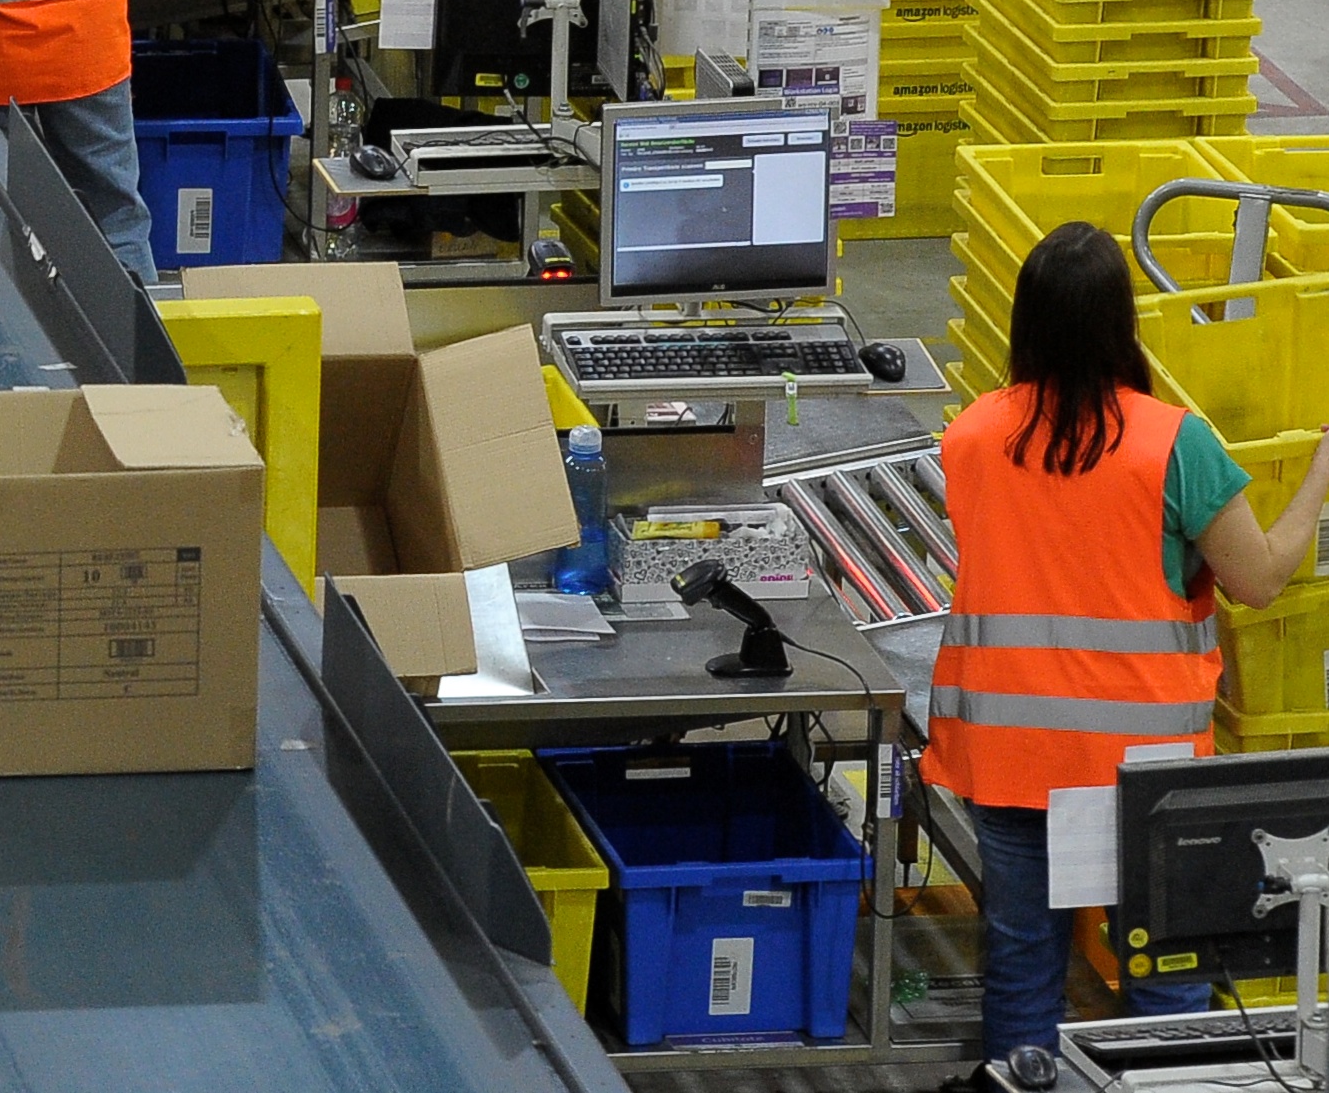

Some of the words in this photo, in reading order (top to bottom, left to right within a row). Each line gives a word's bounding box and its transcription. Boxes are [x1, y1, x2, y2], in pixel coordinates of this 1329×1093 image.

[896, 7, 941, 22] amazon
[893, 85, 939, 97] amazon
[897, 122, 932, 136] mazon
[84, 569, 101, 582] 10
